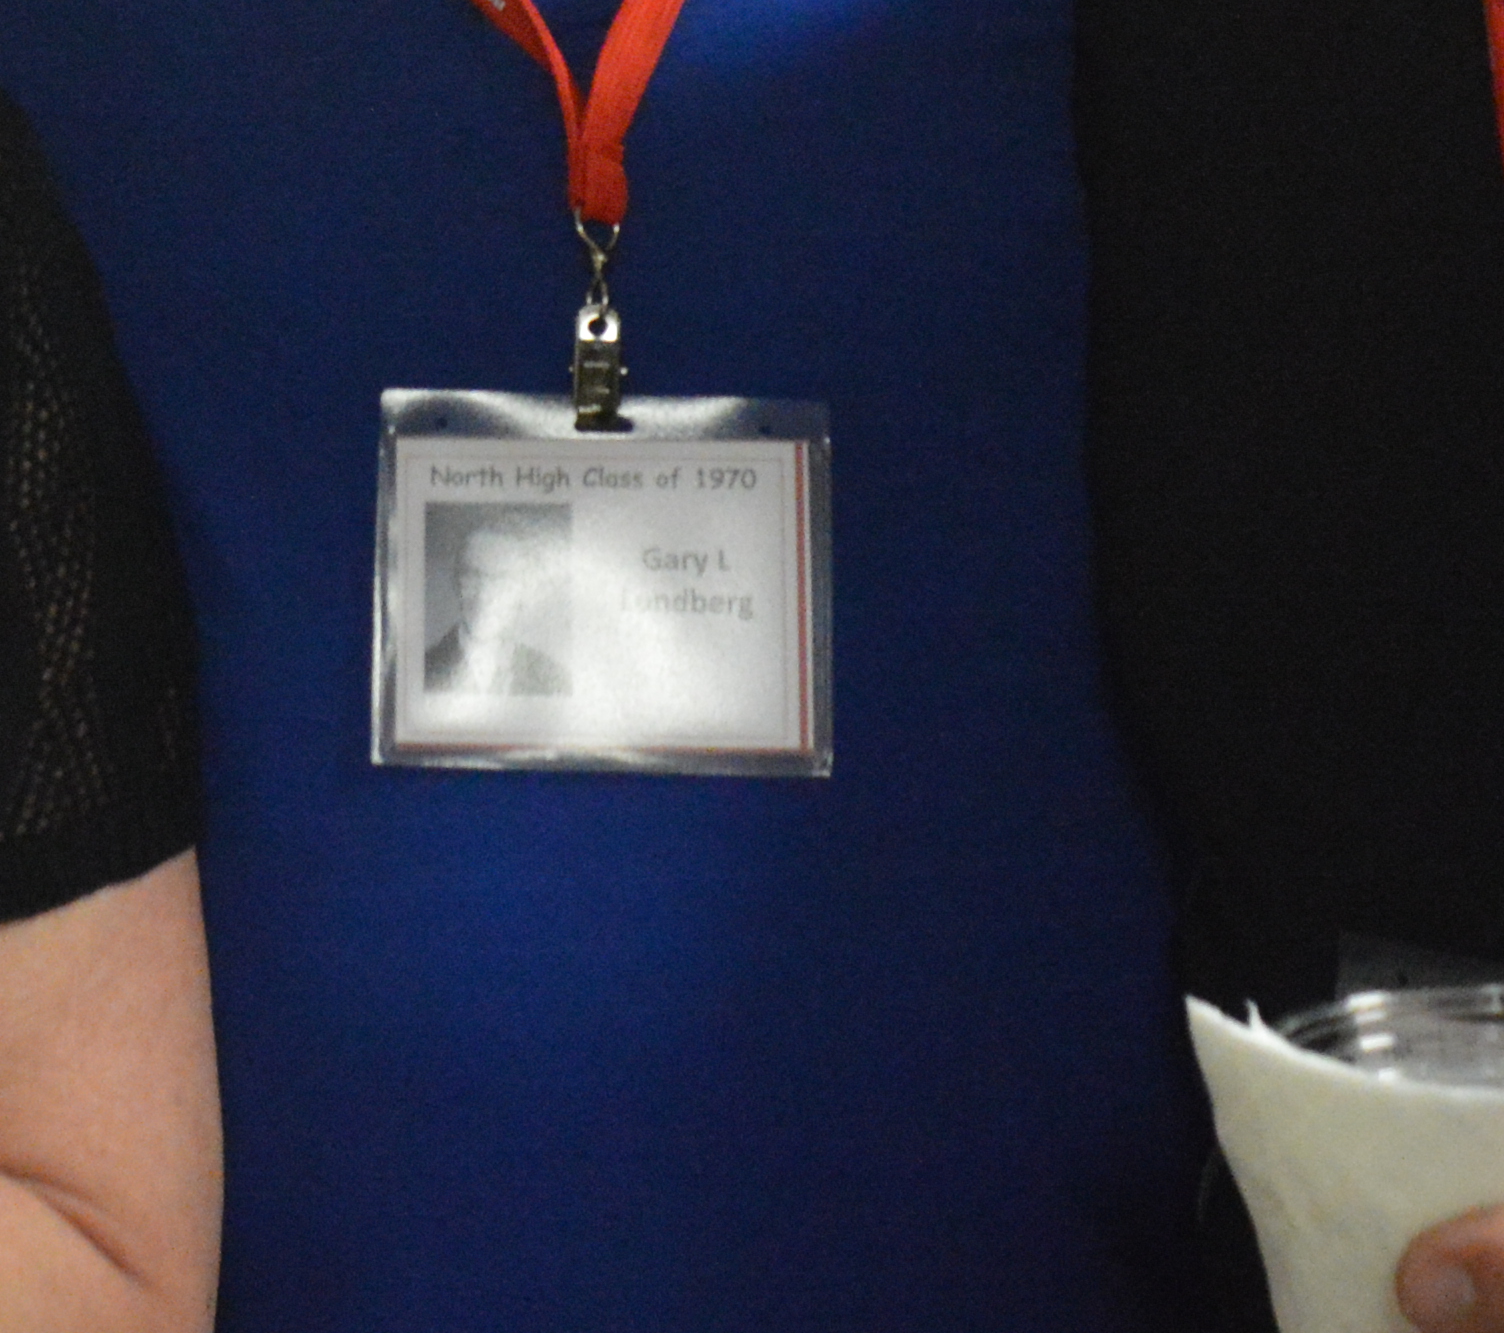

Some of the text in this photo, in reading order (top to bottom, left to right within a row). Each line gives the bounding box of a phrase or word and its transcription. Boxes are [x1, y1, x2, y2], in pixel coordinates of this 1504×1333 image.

[429, 464, 757, 493] North High Class of 1970
[642, 546, 730, 579] Gary L
